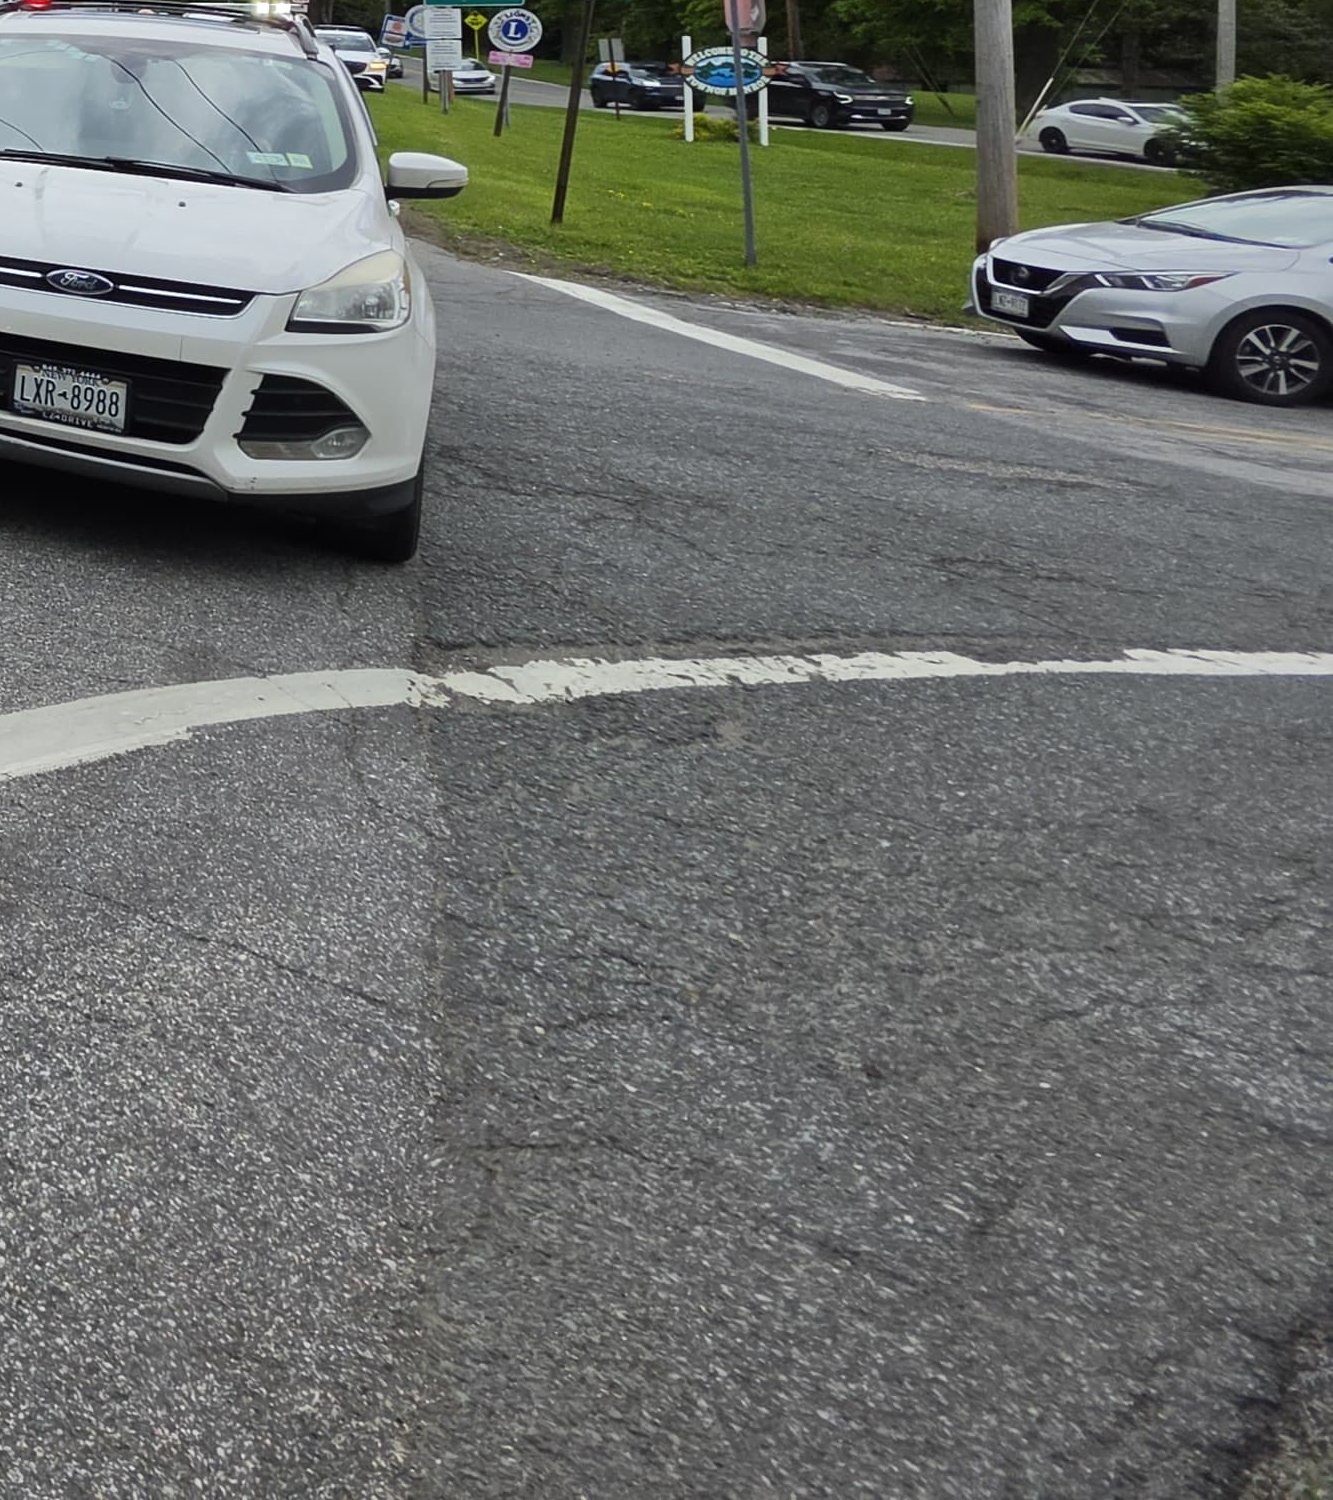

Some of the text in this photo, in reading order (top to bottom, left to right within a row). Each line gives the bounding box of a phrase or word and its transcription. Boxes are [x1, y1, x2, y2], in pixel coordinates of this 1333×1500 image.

[507, 21, 521, 38] L
[729, 76, 771, 96] MNROE
[60, 272, 97, 291] Ford
